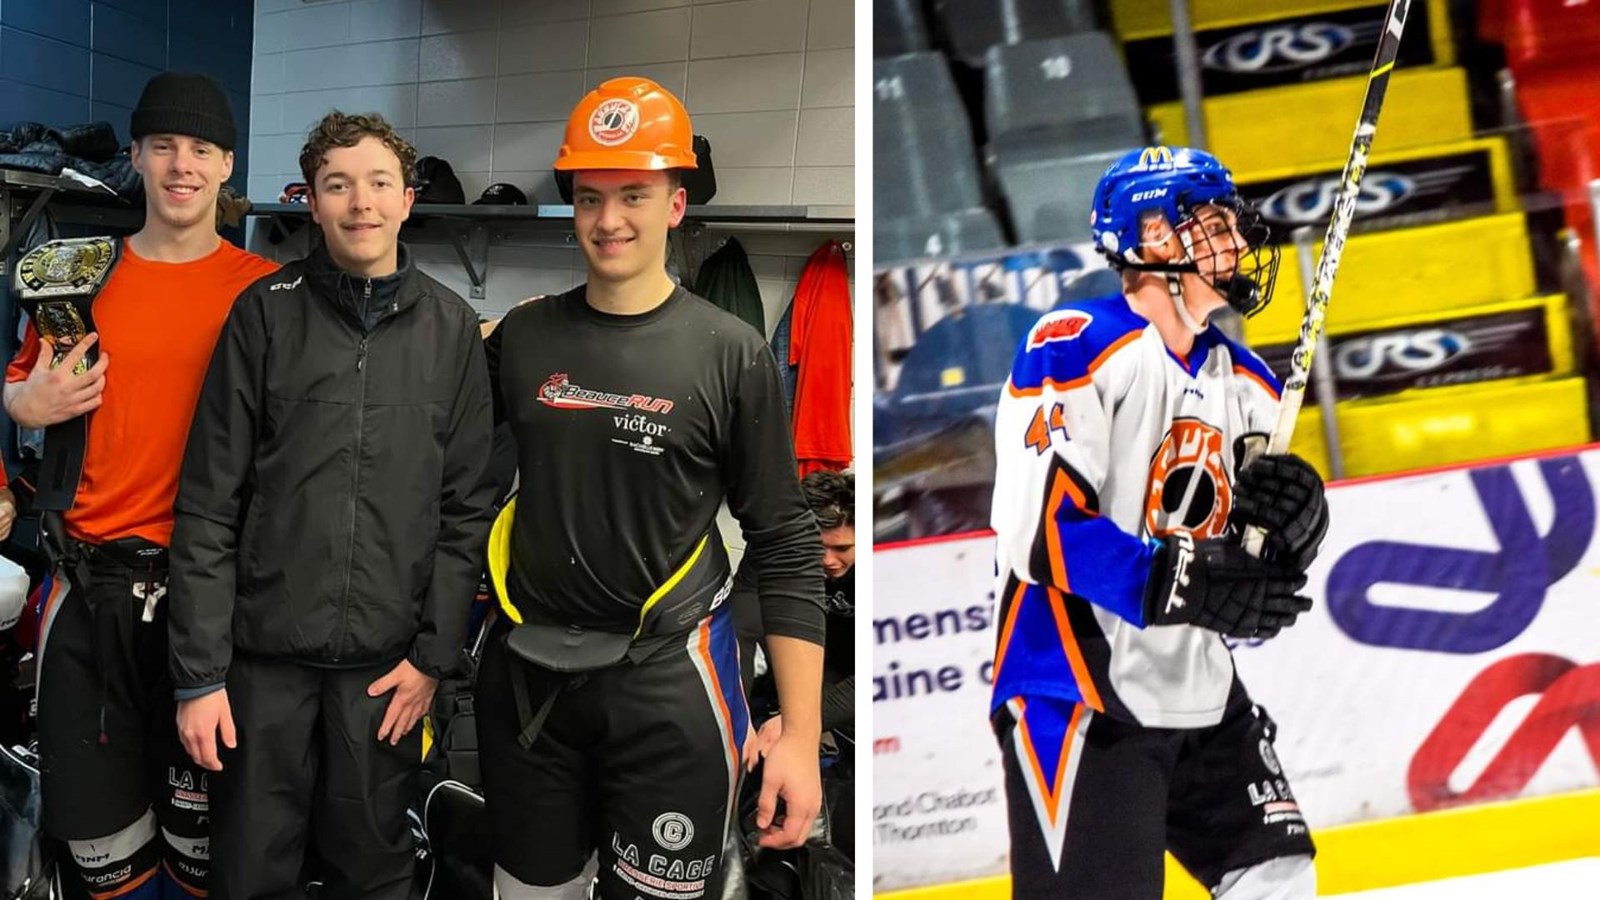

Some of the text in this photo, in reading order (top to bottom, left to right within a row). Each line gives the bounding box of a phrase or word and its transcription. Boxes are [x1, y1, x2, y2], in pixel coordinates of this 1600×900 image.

[613, 413, 667, 436] victor
[612, 831, 715, 880] LA CAGE
